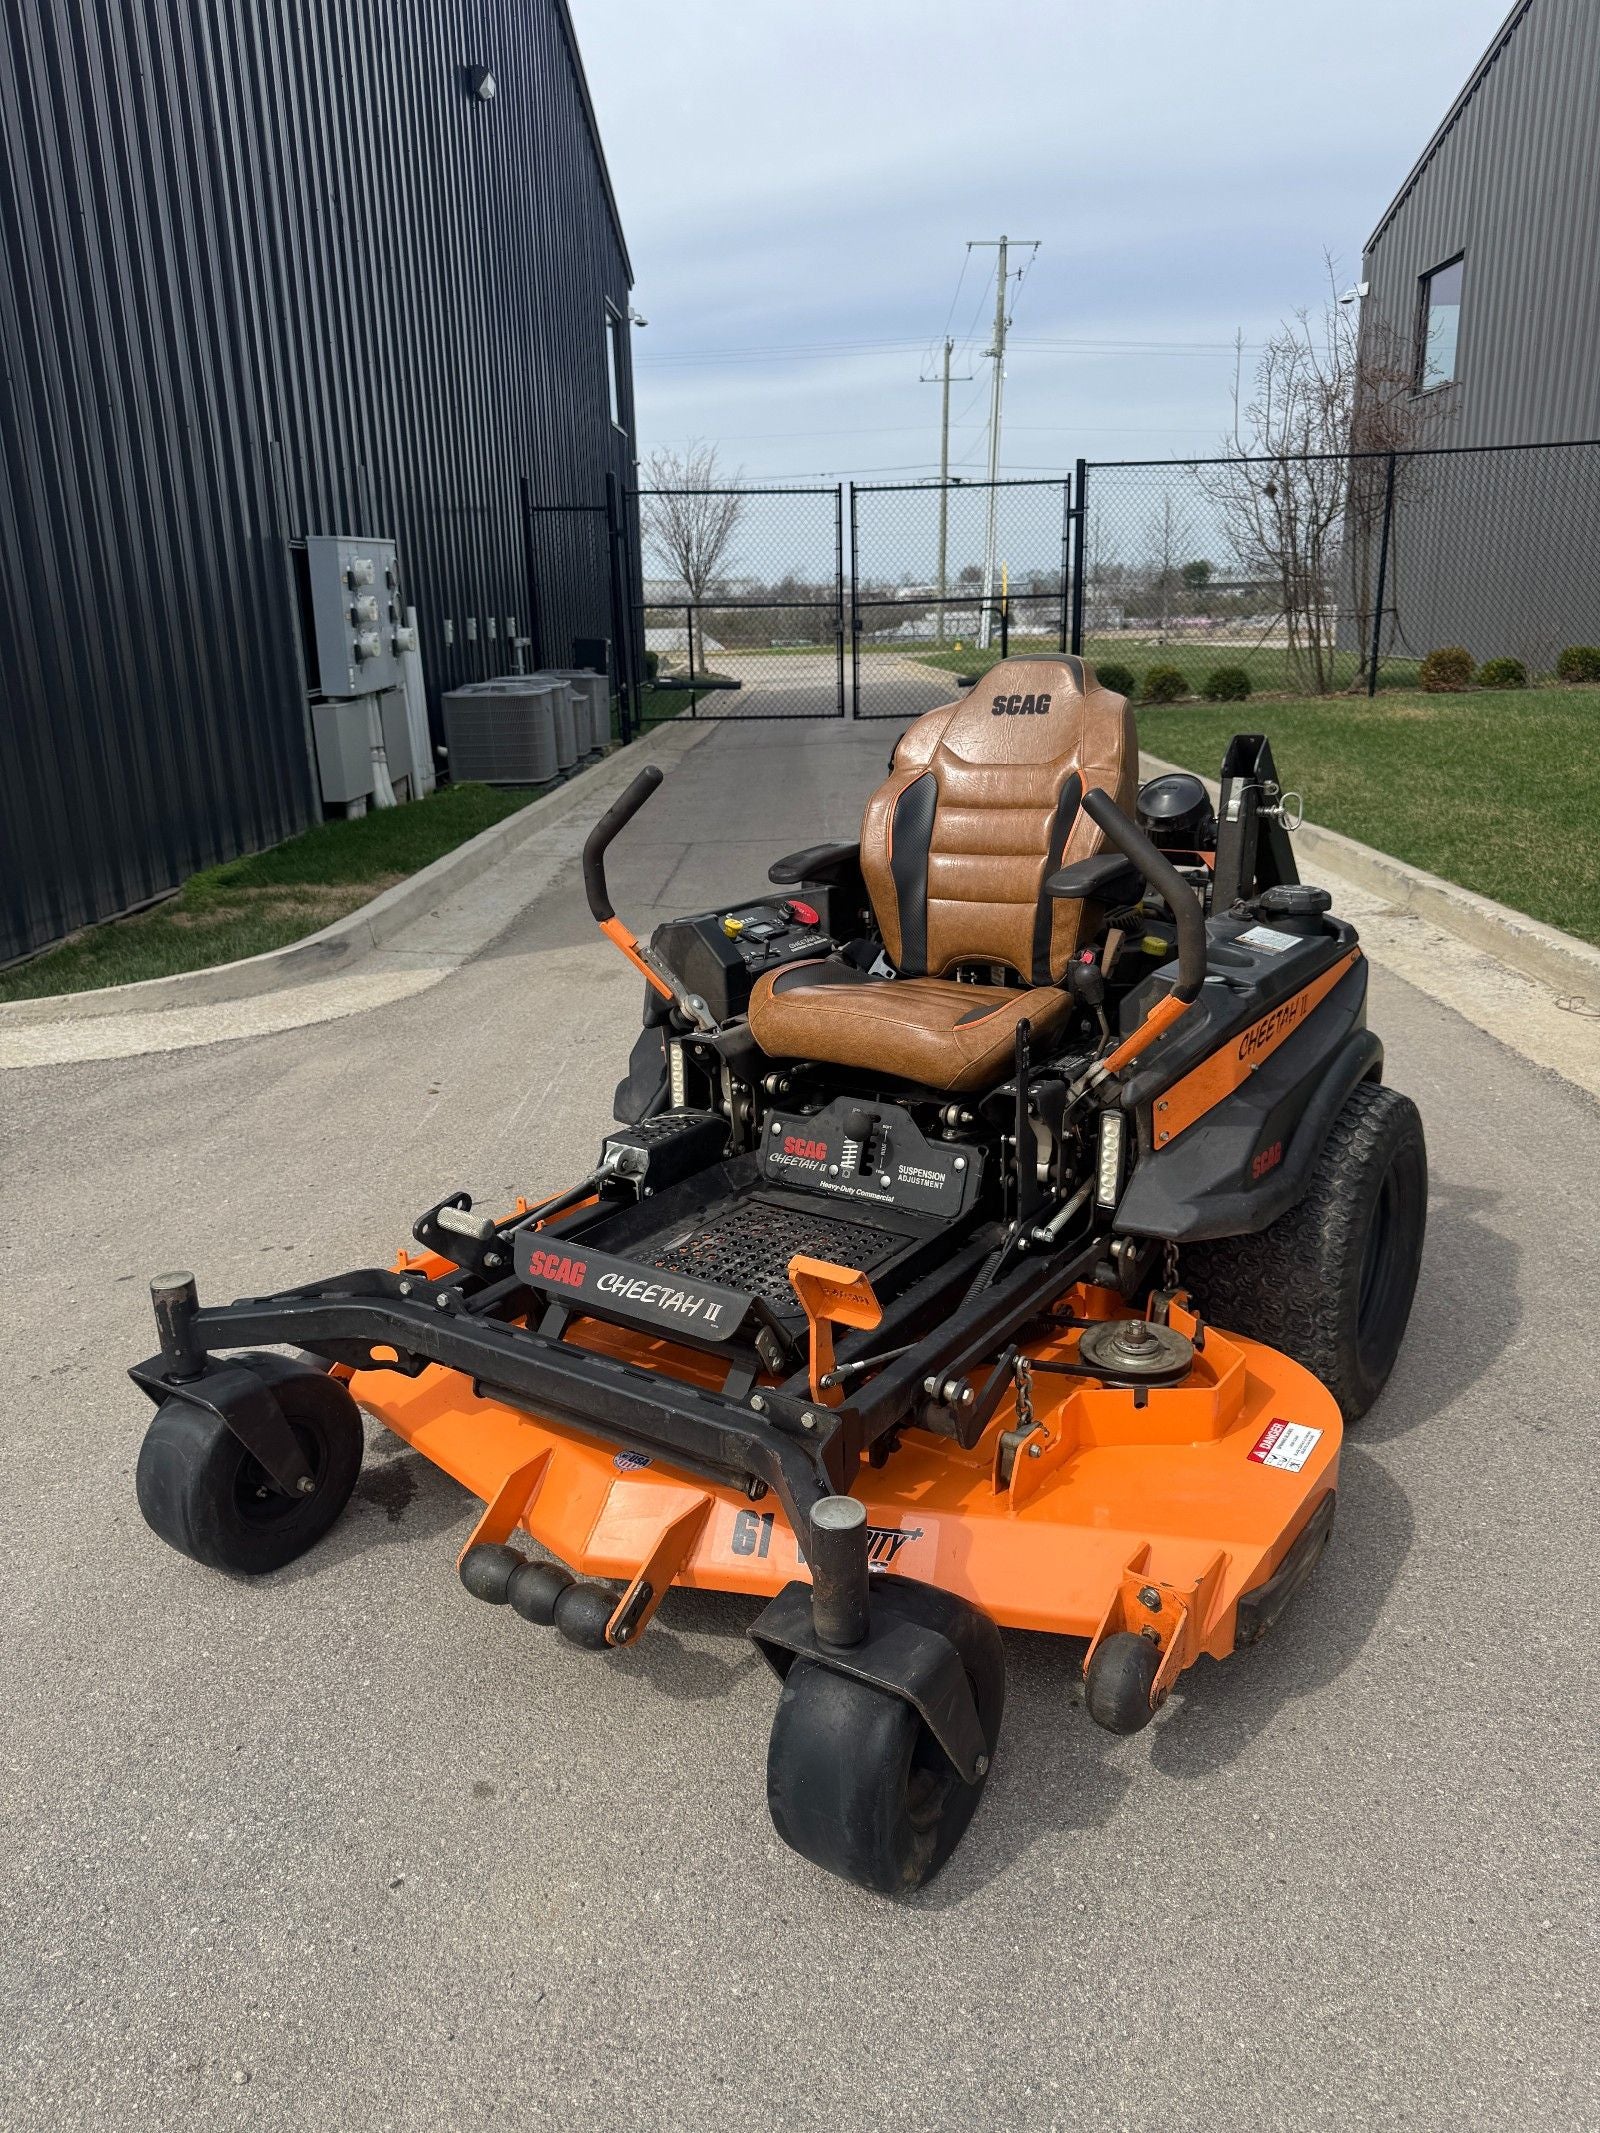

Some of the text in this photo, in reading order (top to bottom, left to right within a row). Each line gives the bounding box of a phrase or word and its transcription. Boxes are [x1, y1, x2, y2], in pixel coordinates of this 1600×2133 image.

[991, 694, 1051, 715] SCAG
[1238, 993, 1309, 1061] CHEETAH II
[784, 1136, 827, 1161] SCAG
[1252, 1141, 1281, 1179] SCAG
[769, 1152, 827, 1172] CHEETAH II
[898, 1164, 946, 1183] SUSPENSION
[819, 1180, 895, 1203] Heavy-Duty Commercial
[897, 1174, 944, 1190] ADJUSTMENT
[529, 1249, 723, 1322] SCAG CHEETAH II
[1259, 1423, 1285, 1450] DANGER
[629, 1454, 651, 1467] USA
[731, 1509, 775, 1558] 61
